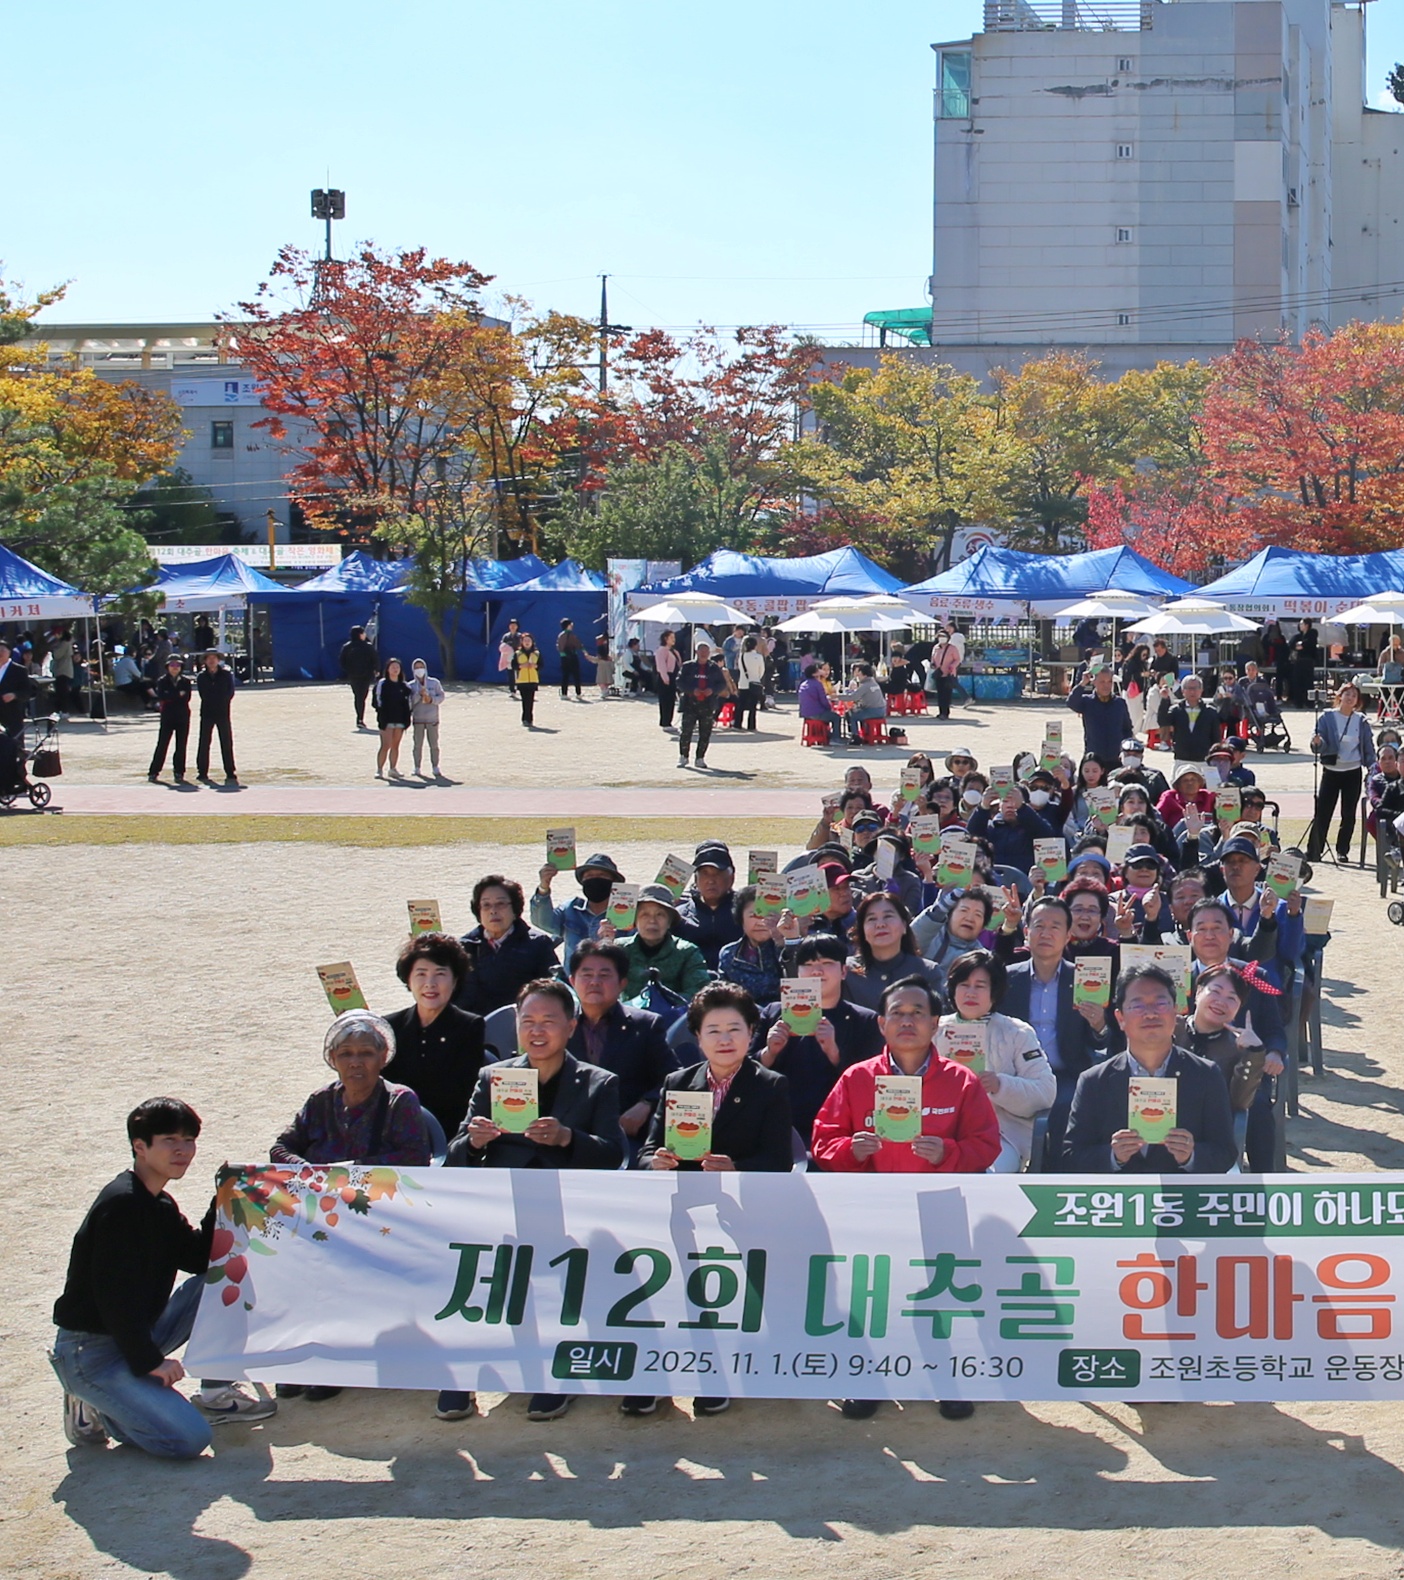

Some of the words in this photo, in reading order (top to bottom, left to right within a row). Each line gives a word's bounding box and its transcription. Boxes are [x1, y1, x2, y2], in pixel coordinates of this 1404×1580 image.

[1054, 1192, 1185, 1227] 조원1동
[1197, 1192, 1302, 1226] 주민이
[434, 1241, 767, 1333] 제12회
[805, 1252, 1081, 1341] 대추골
[1116, 1251, 1397, 1341] 한마음
[569, 1344, 625, 1375] 일시
[644, 1350, 718, 1375] 2025.
[732, 1352, 759, 1375] 11.
[772, 1352, 839, 1380] 1.(토)
[848, 1354, 912, 1378] 9:40
[949, 1356, 1024, 1379] 16:30
[1071, 1353, 1127, 1382] 장소
[1148, 1354, 1315, 1382] 조원초등학교
